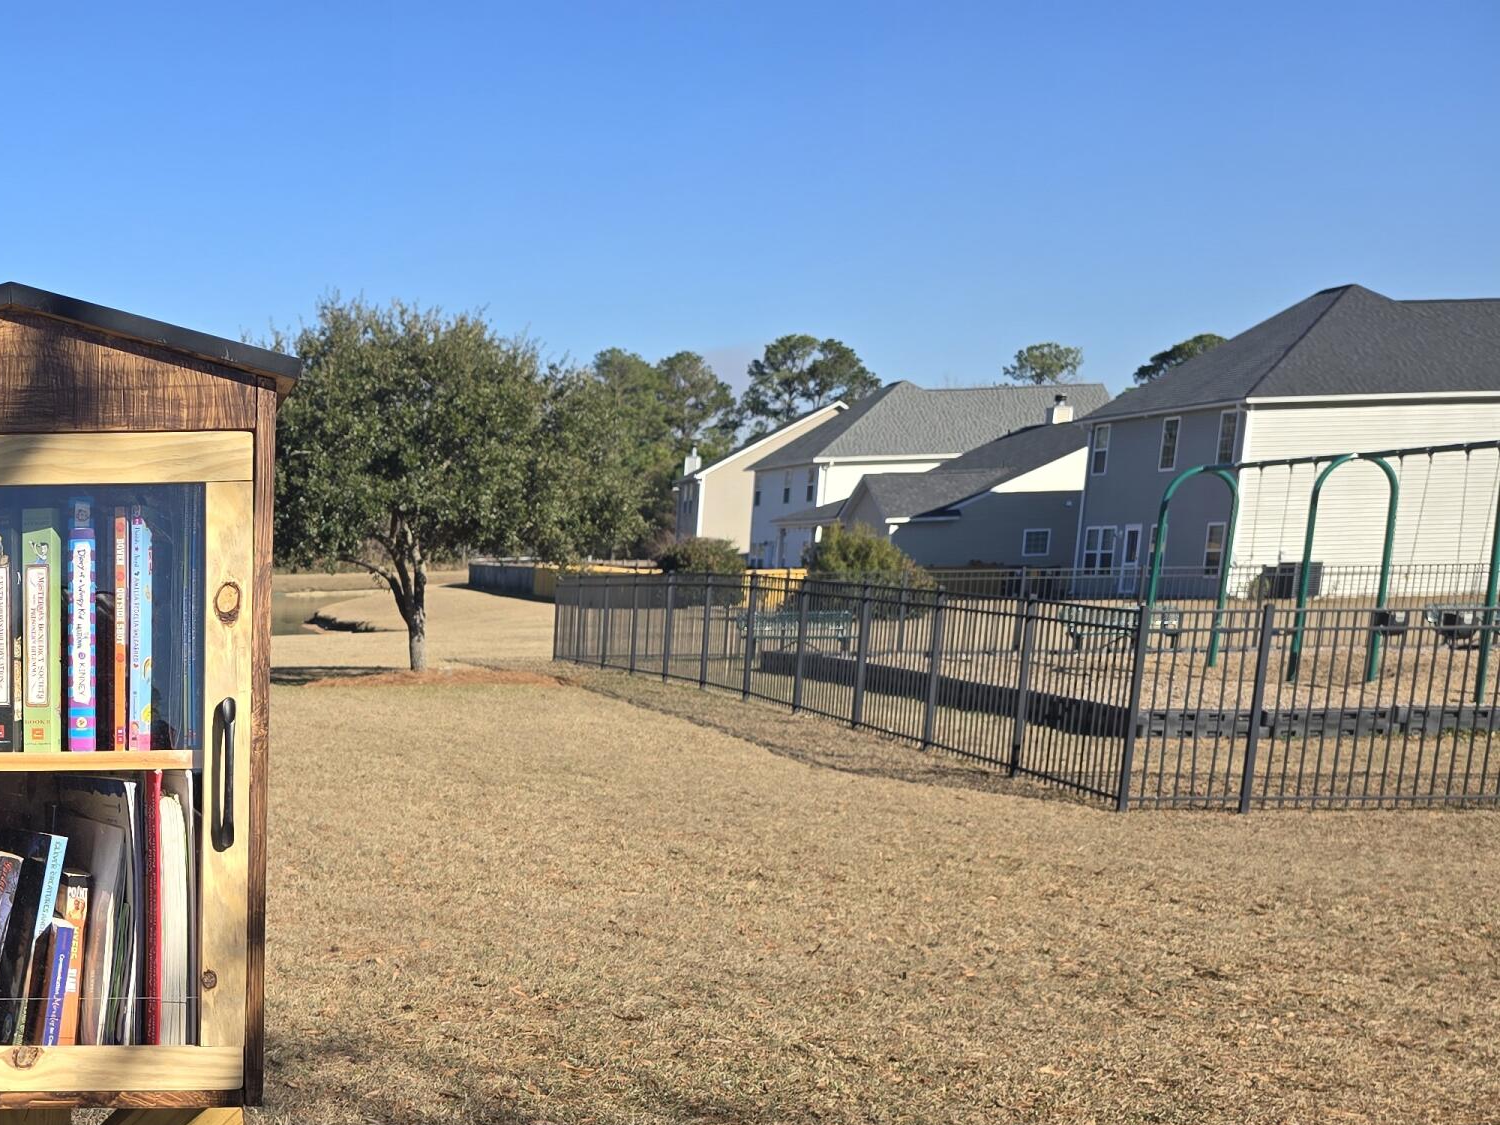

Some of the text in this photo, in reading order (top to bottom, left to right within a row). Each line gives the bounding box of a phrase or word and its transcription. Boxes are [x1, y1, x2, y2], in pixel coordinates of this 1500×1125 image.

[77, 548, 86, 571] Diary
[77, 583, 86, 608] Wimpy
[78, 608, 86, 620] Kid
[37, 666, 45, 699] SOCIETY
[78, 662, 86, 696] KINNEY
[43, 871, 56, 914] CREATURES
